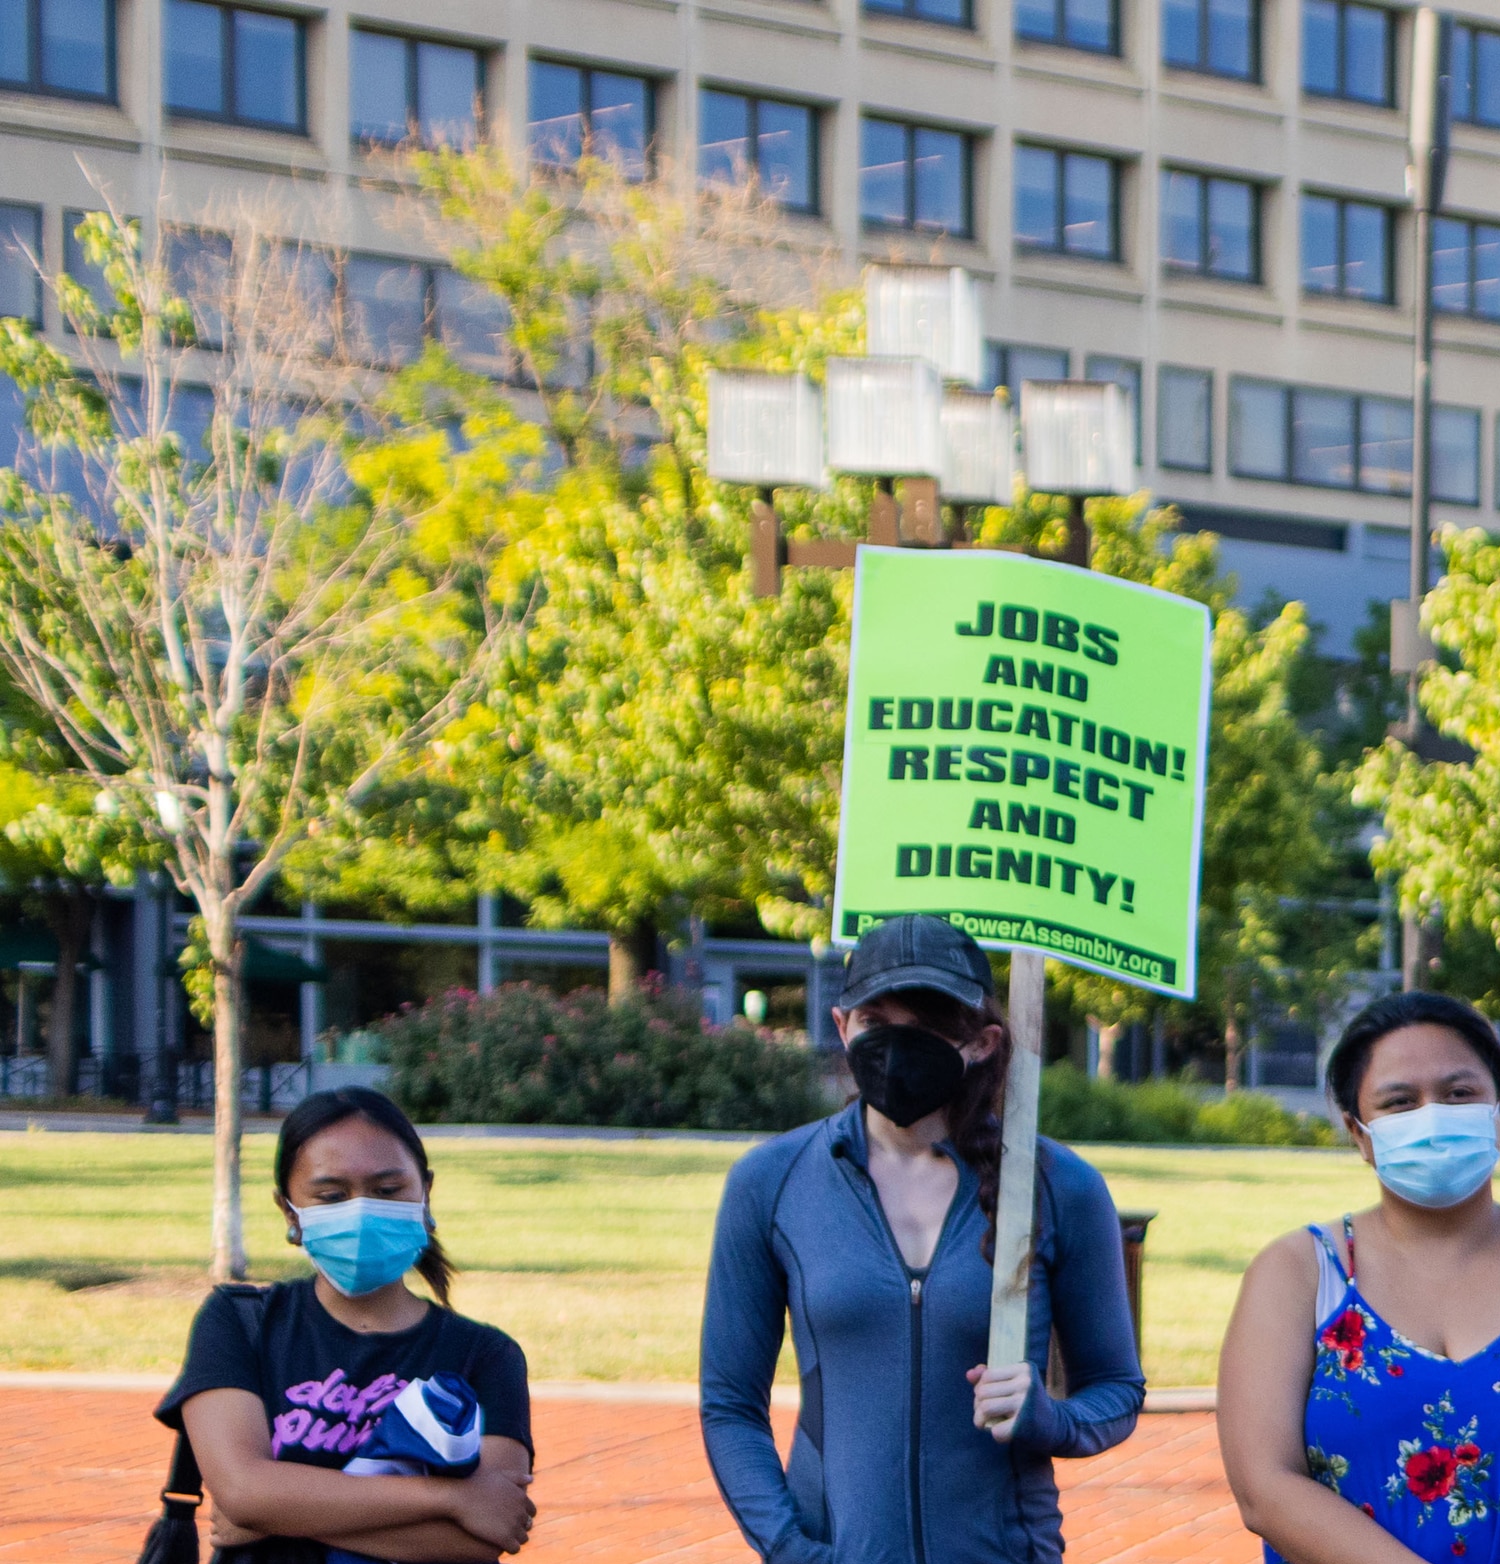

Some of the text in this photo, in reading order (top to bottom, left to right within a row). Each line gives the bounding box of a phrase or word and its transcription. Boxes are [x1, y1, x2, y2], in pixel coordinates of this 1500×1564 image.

[955, 601, 1120, 666] JOBS
[983, 654, 1089, 702] AND
[868, 696, 1186, 781] EDUCATION!
[888, 744, 1155, 821] RESPECT
[968, 799, 1076, 845] AND
[895, 843, 1135, 913] DIGNITY!
[858, 914, 1163, 978] PPowerAssembly.org
[271, 1409, 383, 1460] pun
